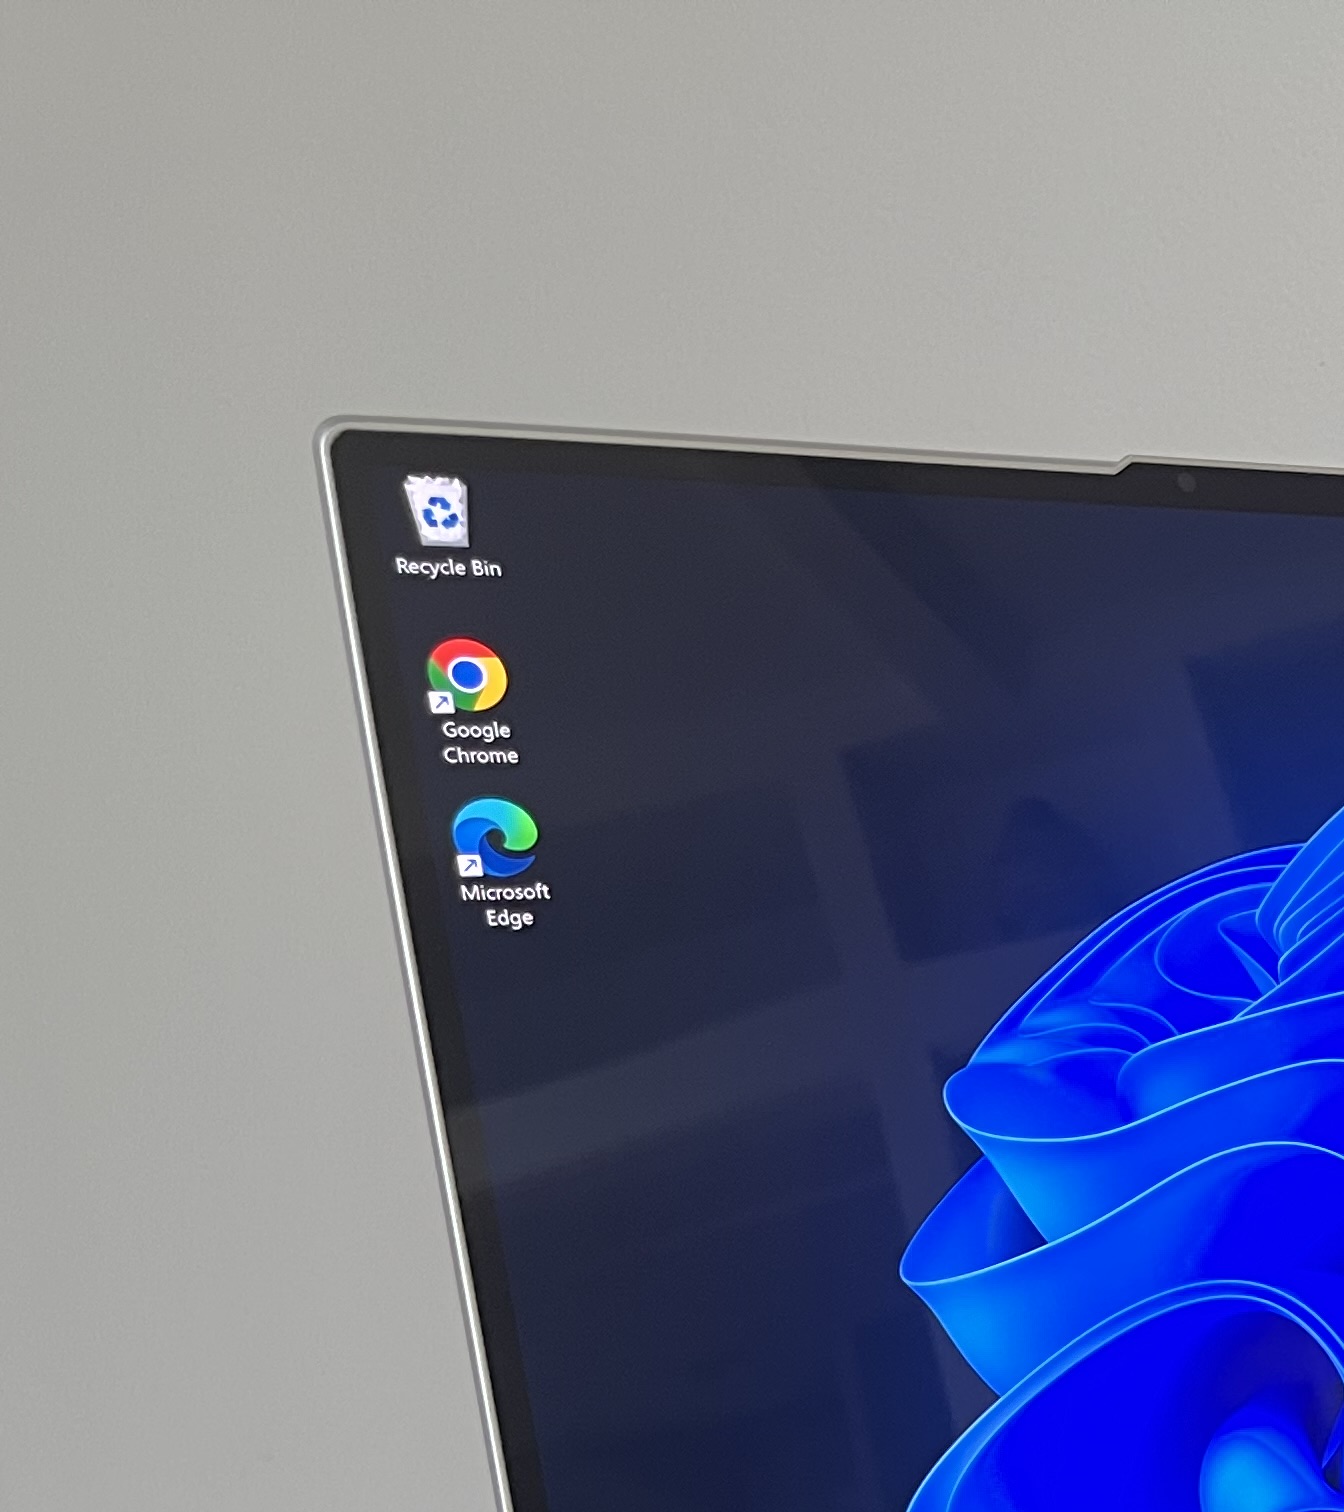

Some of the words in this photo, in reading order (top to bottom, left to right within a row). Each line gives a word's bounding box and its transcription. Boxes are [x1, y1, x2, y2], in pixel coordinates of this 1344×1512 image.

[396, 557, 466, 578] Recycle
[472, 560, 502, 577] Bin
[442, 722, 511, 743] Google
[443, 747, 519, 764] Chrome
[460, 884, 551, 901] Microsoft
[486, 909, 534, 930] Edge
